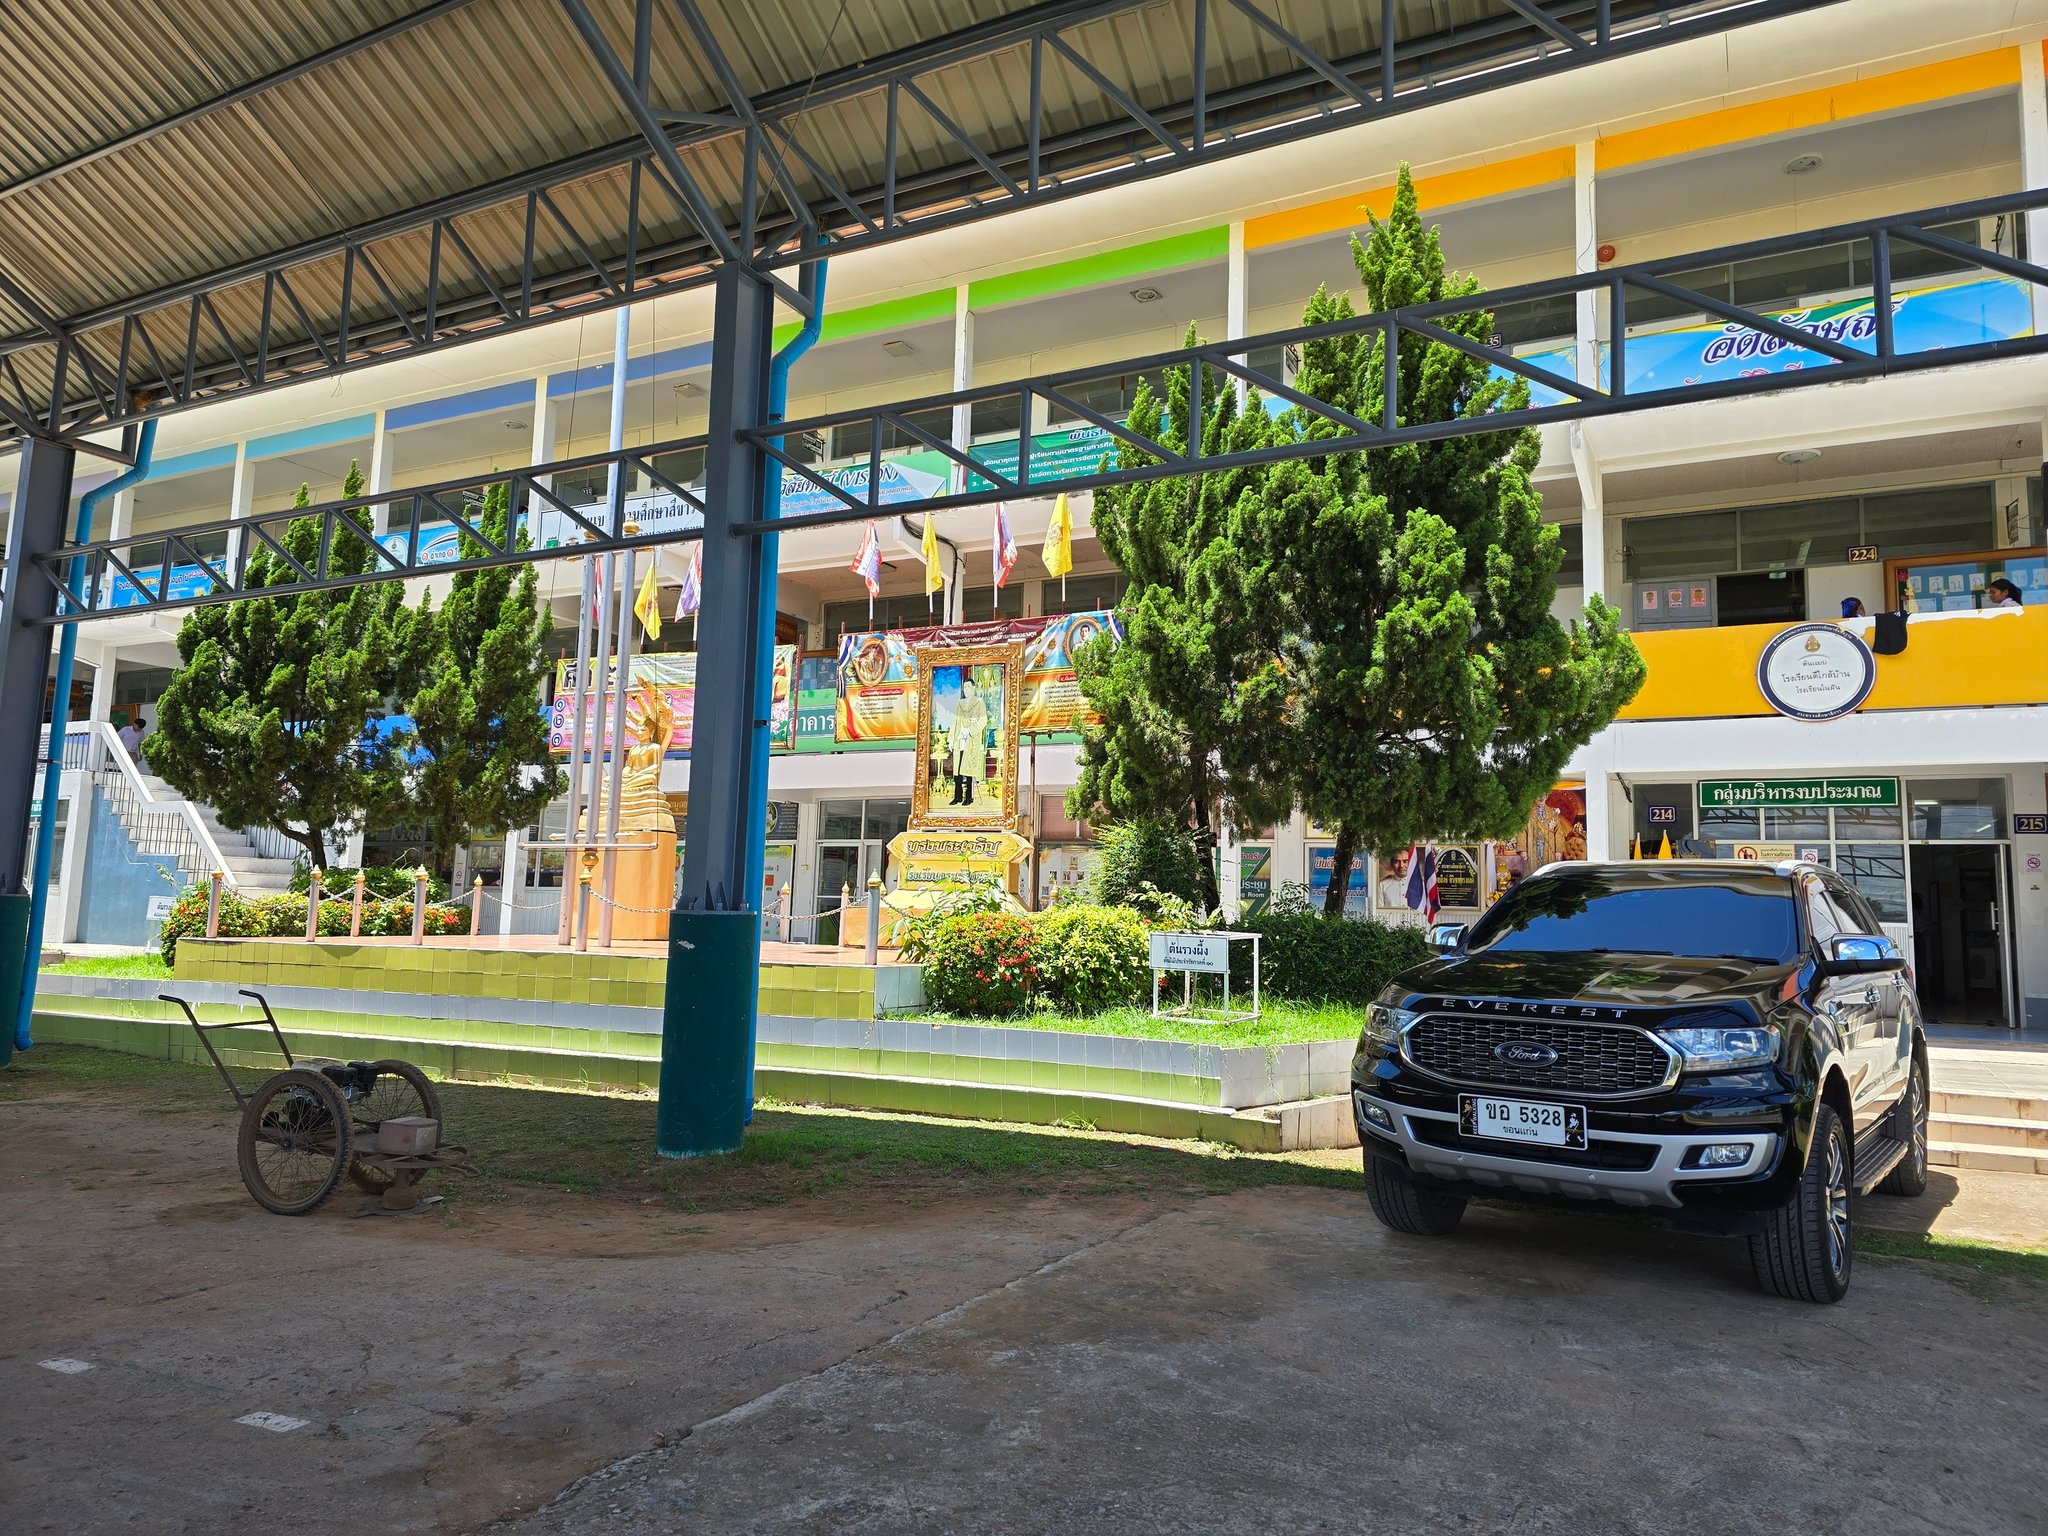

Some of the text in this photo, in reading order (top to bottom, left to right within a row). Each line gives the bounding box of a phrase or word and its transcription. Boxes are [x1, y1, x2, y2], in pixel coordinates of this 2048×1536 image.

[840, 464, 900, 488] (VISON)
[1852, 549, 1876, 562] 224
[1781, 670, 1850, 683] โรงเรียนดีใกล้บ้าน
[1713, 783, 1882, 806] กลุ่มบริหารงบประมาณ
[1652, 809, 1673, 820] 214
[2020, 818, 2044, 830] 215
[1169, 940, 1209, 956] ต้นรวงผึ้ง
[1442, 999, 1627, 1018] EVEREST
[1507, 1045, 1540, 1061] Ford
[1486, 1103, 1562, 1127] ขอ 5328
[1502, 1126, 1538, 1136] ขอนแก่น
